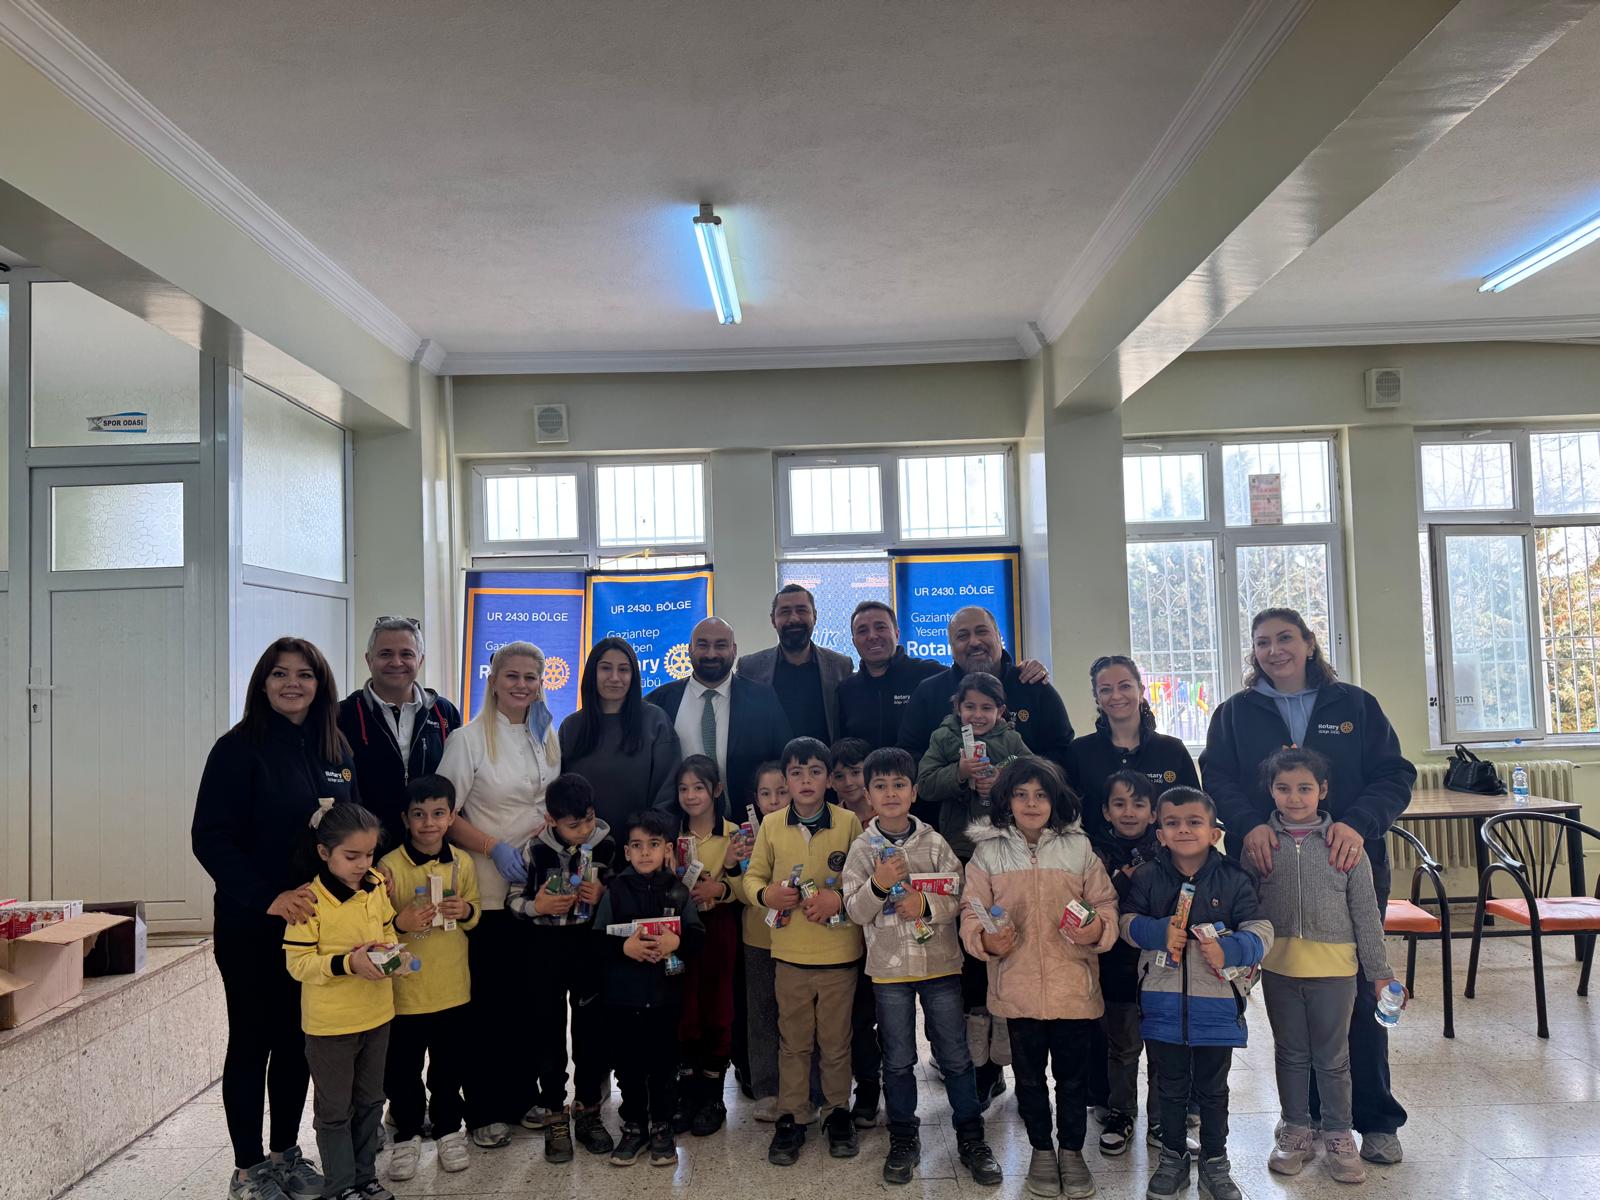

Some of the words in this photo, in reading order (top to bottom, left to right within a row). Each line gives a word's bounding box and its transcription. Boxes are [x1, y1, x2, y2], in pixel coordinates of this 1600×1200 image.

[914, 587, 929, 597] UR
[931, 587, 957, 596] 2430.
[959, 584, 995, 595] BÖLGE
[610, 605, 625, 615] UR
[627, 603, 654, 613] 2430.
[656, 600, 692, 612] BÖLGE
[487, 612, 503, 621] UR
[505, 612, 529, 622] 2430
[531, 610, 569, 622] BÖLGE
[1318, 723, 1339, 731] Rotary
